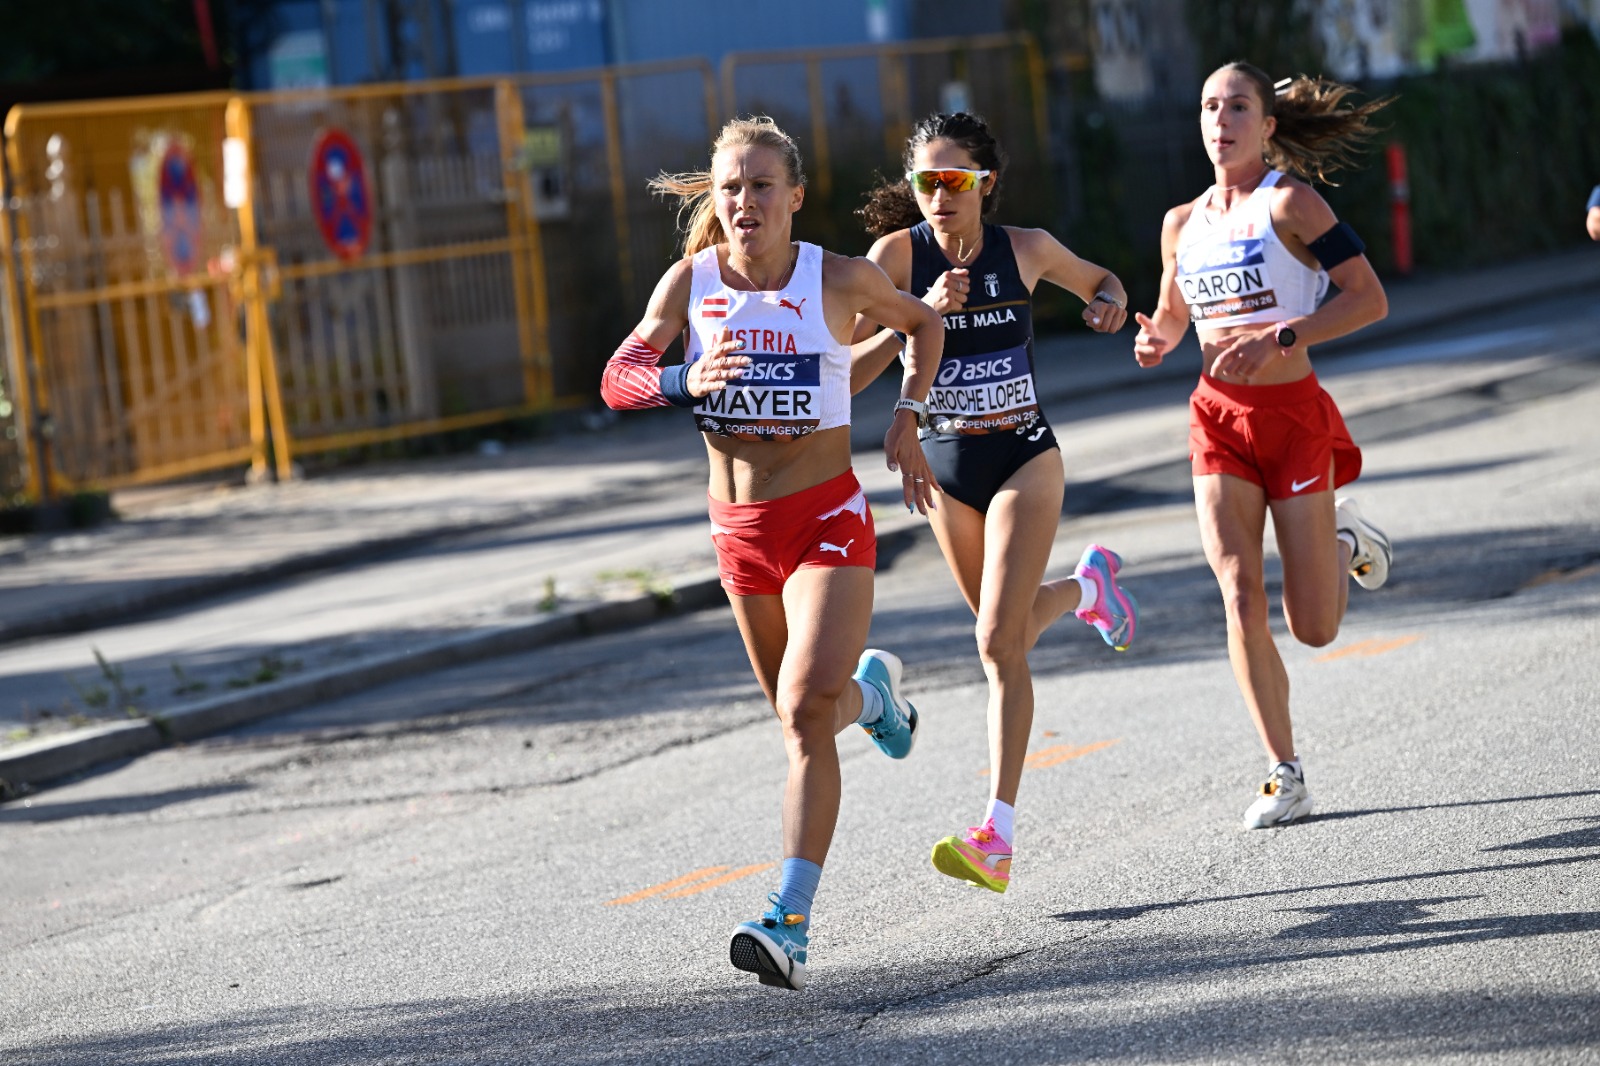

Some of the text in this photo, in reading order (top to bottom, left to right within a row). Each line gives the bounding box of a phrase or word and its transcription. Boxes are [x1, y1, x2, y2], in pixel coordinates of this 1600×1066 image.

[1184, 267, 1263, 299] CARON
[1259, 295, 1273, 306] 26
[973, 309, 1016, 328] MALA
[702, 390, 812, 416] MAYER
[988, 378, 1031, 410] LOPEZ
[725, 424, 800, 435] COPENHAGEN
[954, 413, 1022, 430] COPENHAGEN
